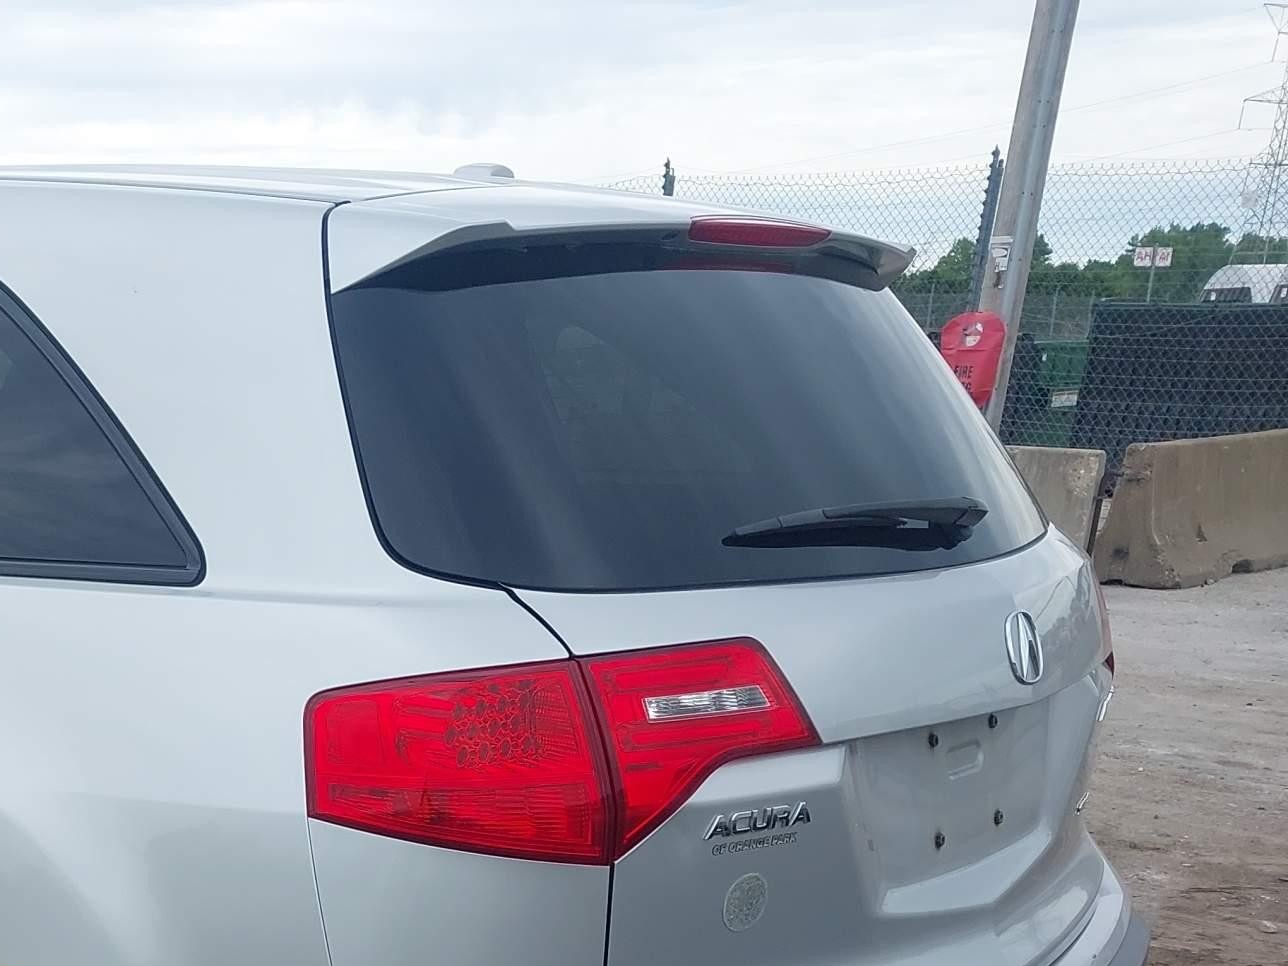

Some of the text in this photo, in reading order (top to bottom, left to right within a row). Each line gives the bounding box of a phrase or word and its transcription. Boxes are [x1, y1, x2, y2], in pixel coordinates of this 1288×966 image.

[703, 801, 811, 841] ACURA
[712, 843, 727, 856] OF
[728, 836, 770, 853] ORANGE
